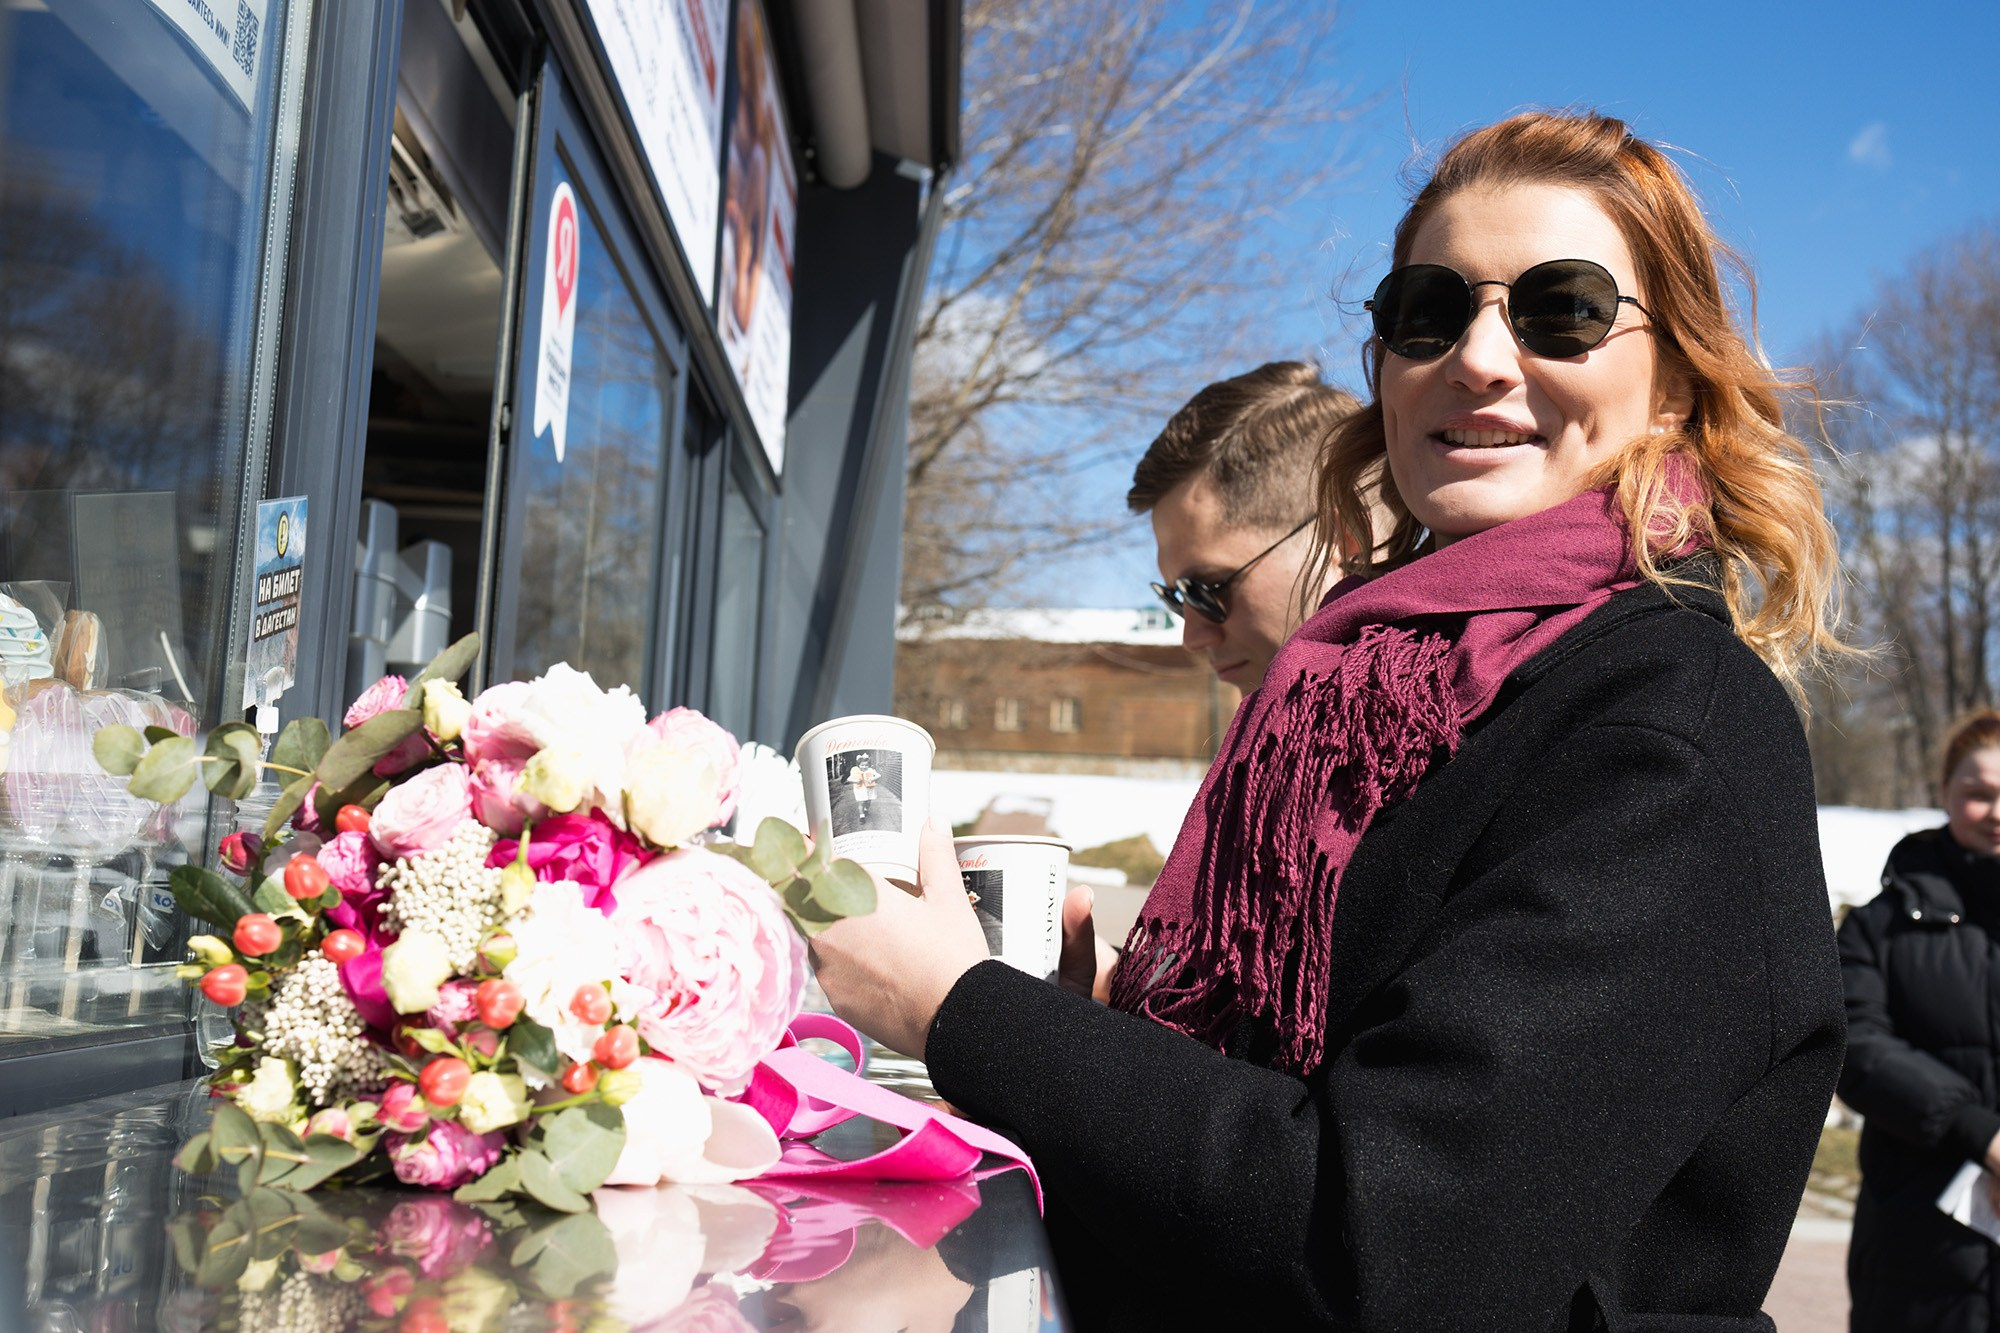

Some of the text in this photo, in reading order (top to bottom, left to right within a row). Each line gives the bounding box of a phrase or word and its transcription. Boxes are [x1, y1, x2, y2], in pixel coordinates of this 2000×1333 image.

[215, 18, 231, 49] ИМИ!
[258, 568, 301, 603] НА БИЛЕТ
[255, 609, 297, 639] В ДАГЕСТАН
